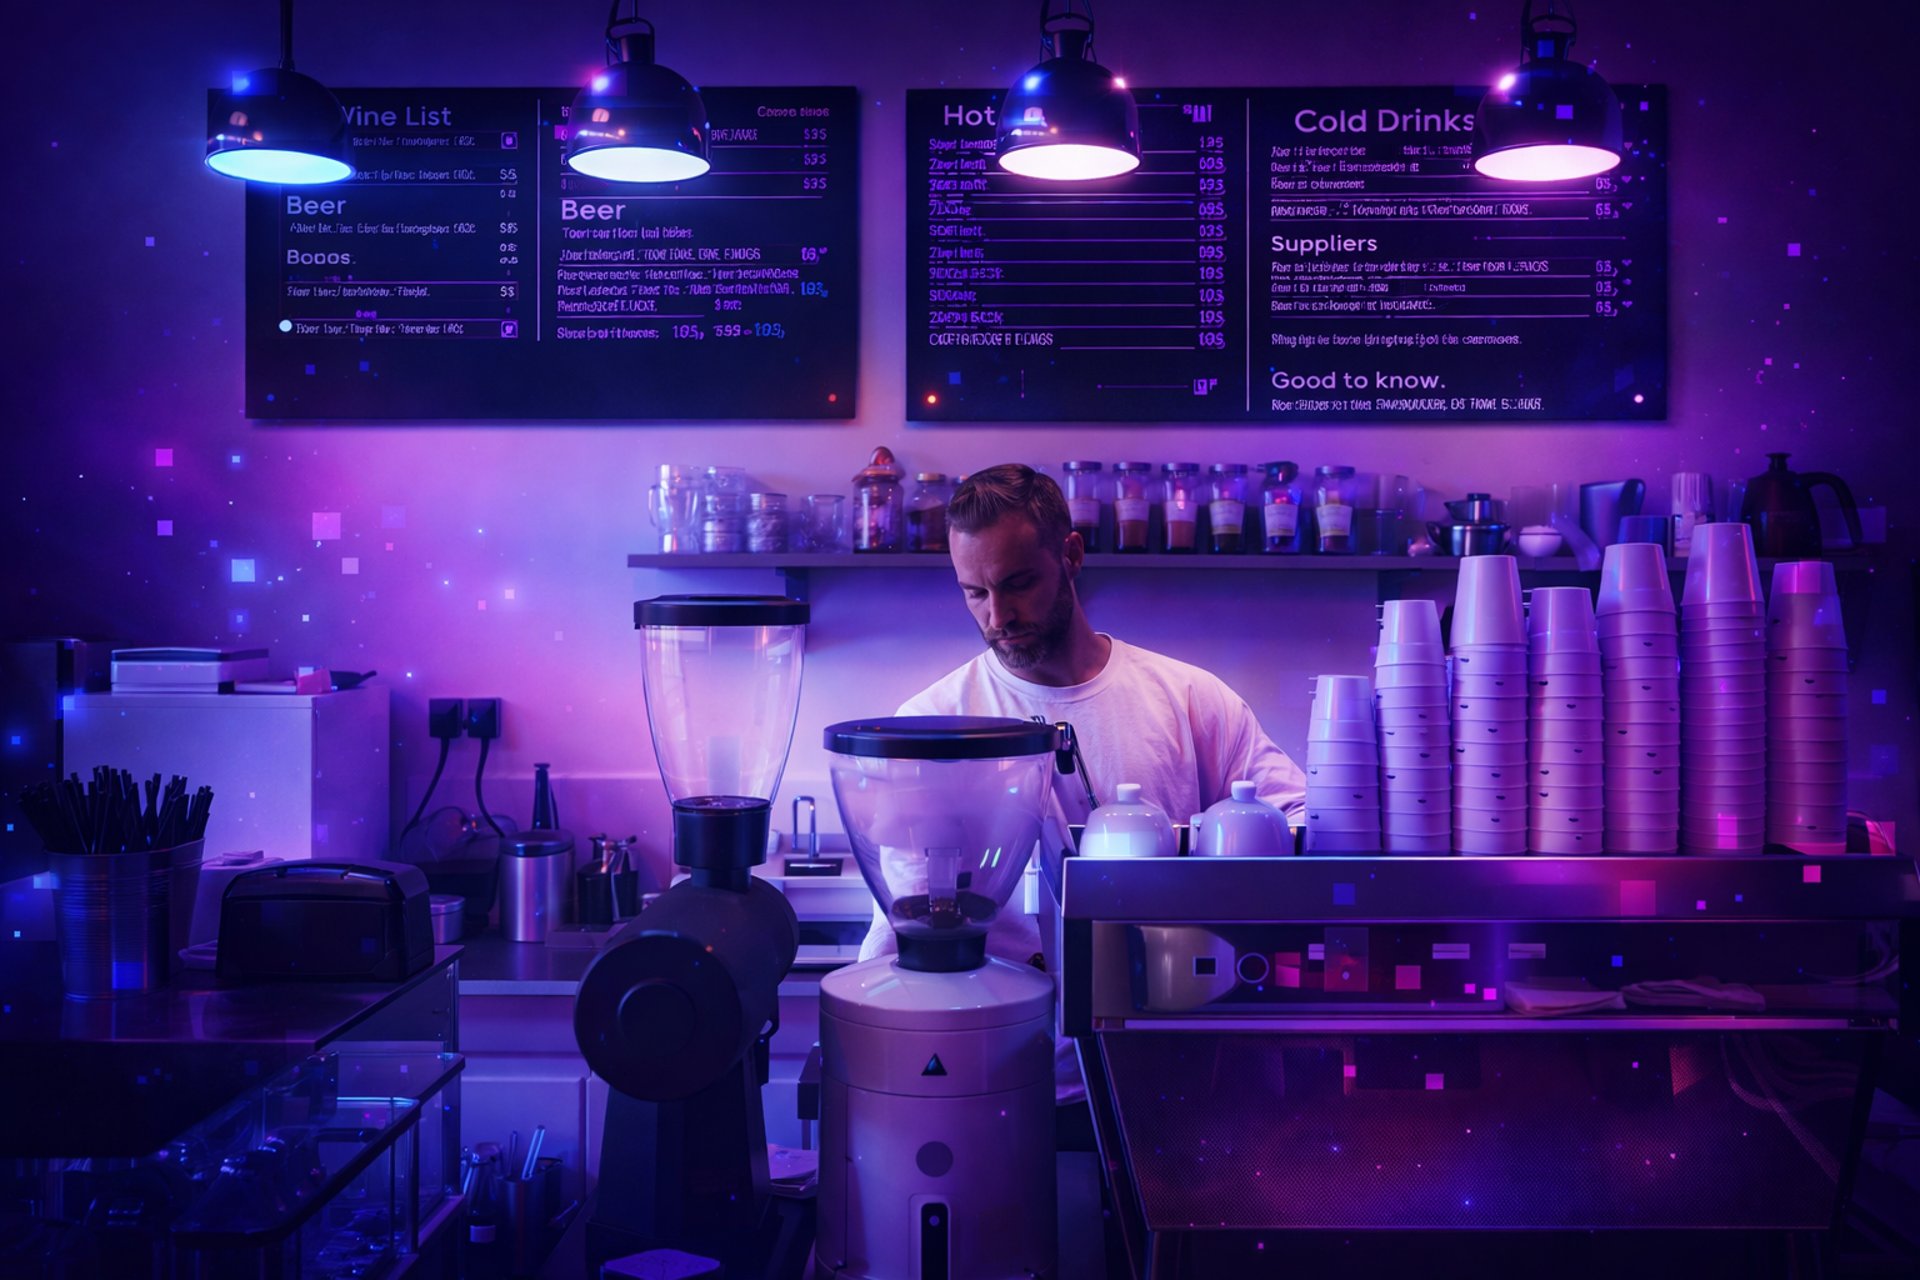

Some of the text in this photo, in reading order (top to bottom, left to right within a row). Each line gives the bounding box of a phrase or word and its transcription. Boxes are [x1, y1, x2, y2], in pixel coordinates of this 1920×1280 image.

[405, 105, 452, 126] List
[944, 104, 996, 126] Hot
[1294, 108, 1475, 133] Cold Drinks
[286, 195, 347, 216] Beer
[561, 199, 627, 221] Beer
[1270, 234, 1378, 257] Suppliers
[1271, 371, 1447, 390] Good to know.
